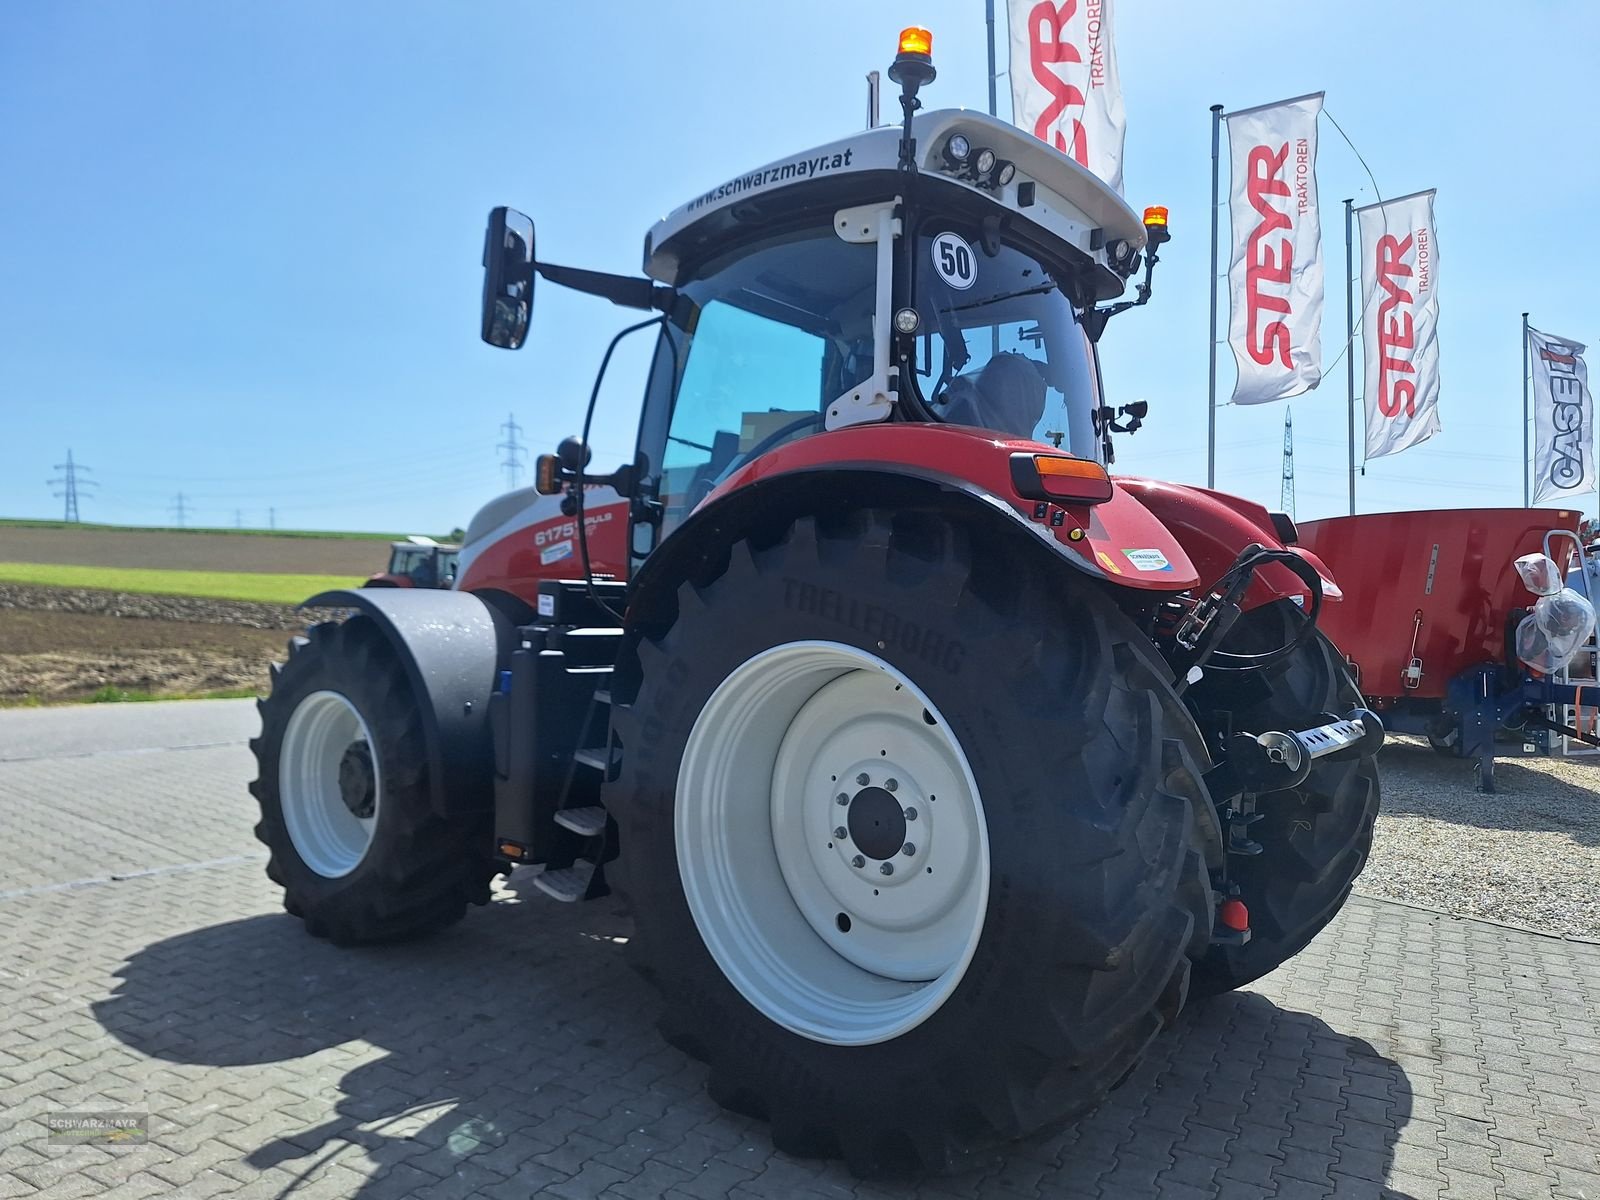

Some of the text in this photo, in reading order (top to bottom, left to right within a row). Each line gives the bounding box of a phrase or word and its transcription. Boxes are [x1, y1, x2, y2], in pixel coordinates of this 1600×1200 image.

[1087, 0, 1105, 89] TRAKTORE
[687, 148, 853, 212] www.schwarzmayr.at
[1296, 138, 1308, 217] TRAKTOREN
[941, 243, 970, 281] 50
[1246, 141, 1294, 371] STEYR
[1418, 227, 1428, 295] TRAKTOREN
[1376, 232, 1416, 420] STEYR
[1550, 376, 1585, 490] CASE
[535, 522, 574, 546] 6175
